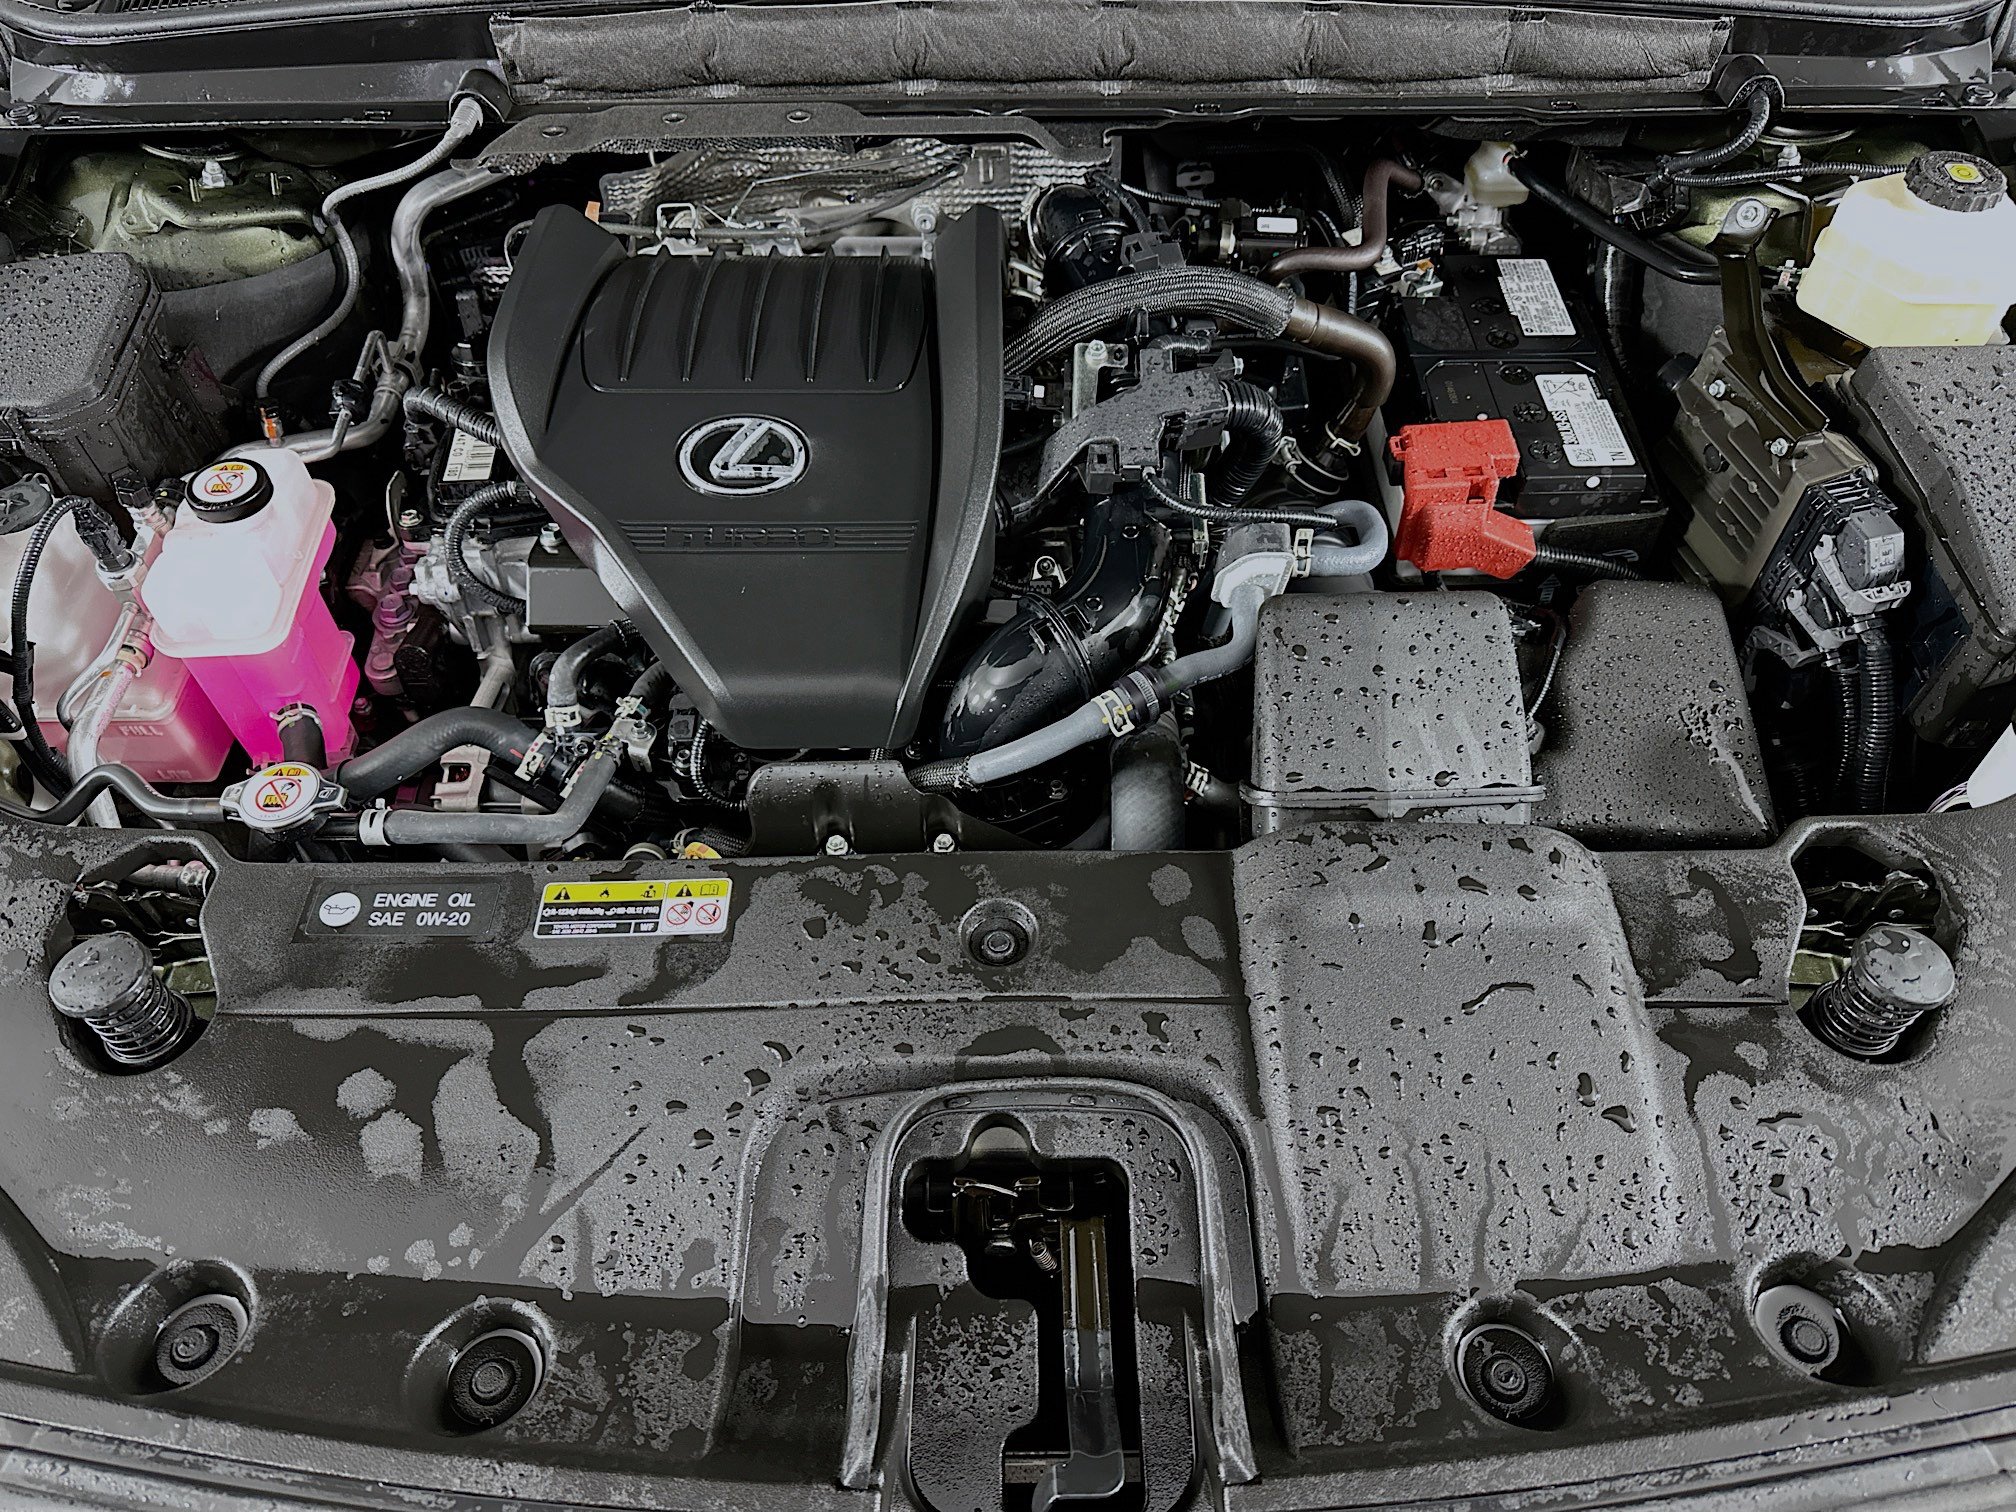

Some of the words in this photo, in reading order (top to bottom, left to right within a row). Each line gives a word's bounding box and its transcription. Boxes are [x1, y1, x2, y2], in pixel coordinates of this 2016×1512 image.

[671, 527, 830, 547] TURBO
[119, 725, 164, 736] FULL
[373, 893, 439, 908] ENGINE
[447, 893, 476, 908] OIL
[368, 911, 406, 927] SAE
[416, 911, 471, 927] 0W-20
[640, 922, 655, 931] WF
